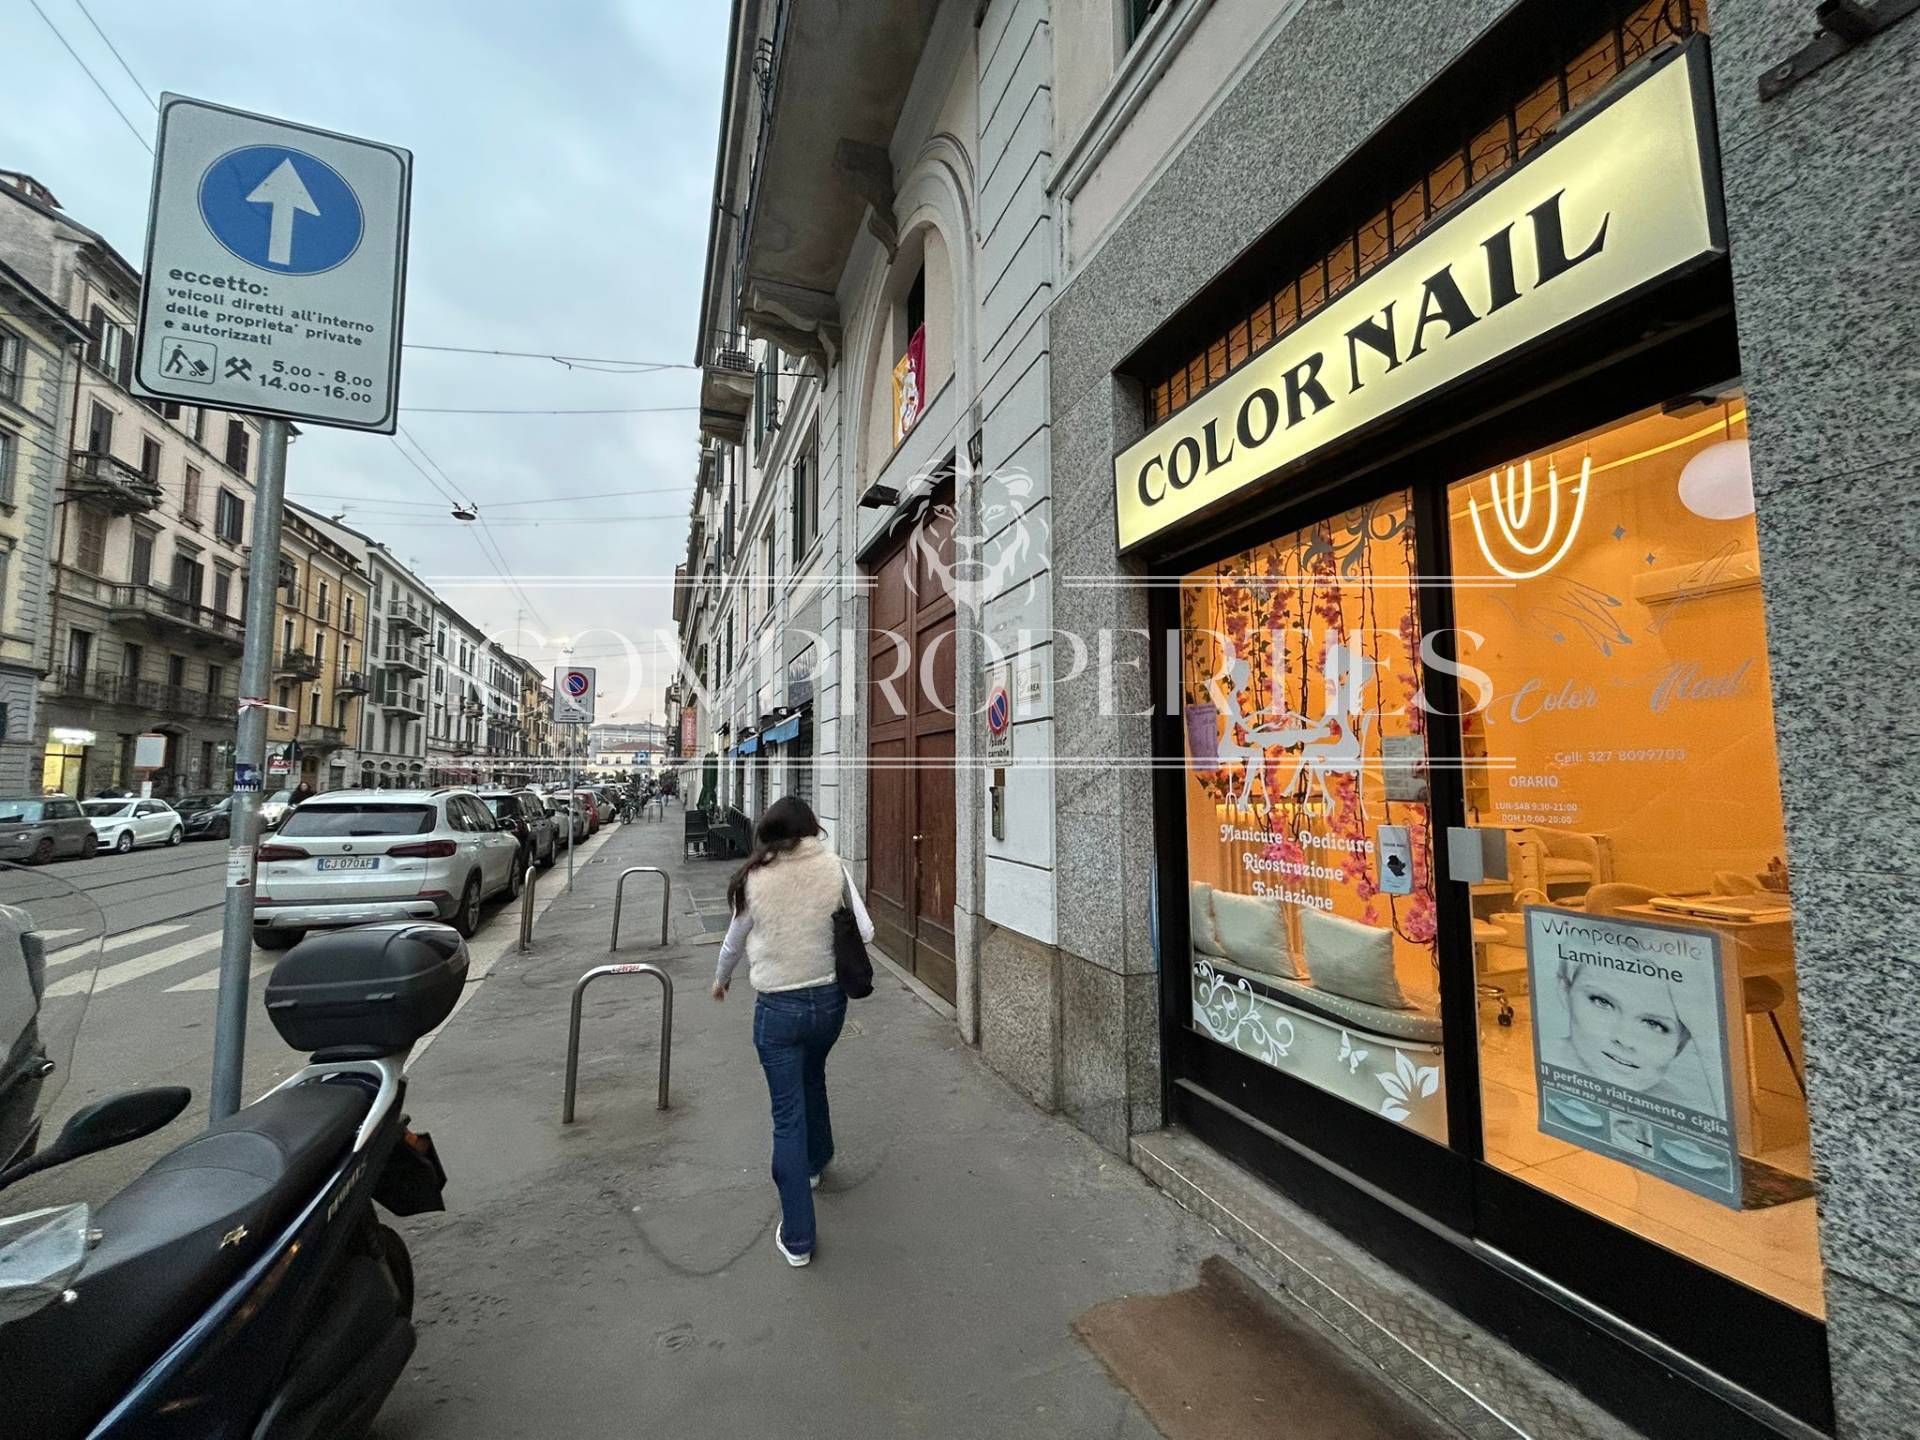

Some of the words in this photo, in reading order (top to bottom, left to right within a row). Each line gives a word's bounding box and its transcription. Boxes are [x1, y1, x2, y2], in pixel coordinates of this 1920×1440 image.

[168, 268, 269, 297] eccetto:
[165, 302, 209, 319] delle
[305, 328, 363, 346] private
[167, 287, 225, 306] veicoli
[231, 297, 284, 316] diretti
[290, 308, 375, 333] all'interno
[164, 319, 175, 329] e
[181, 321, 272, 346] autorizzati
[1137, 351, 1335, 507] COLOR
[1342, 187, 1611, 394] NAIL
[272, 359, 312, 378] 5.00
[334, 370, 373, 388] 8.00
[258, 374, 372, 404] 14.00-16.00
[1485, 678, 1599, 725] Color
[1588, 751, 1613, 763] 327
[1508, 775, 1559, 788] ORARIO
[1219, 823, 1283, 844] Manicure
[1299, 830, 1375, 853] Pedicure
[1242, 852, 1344, 881] Ricostruzione
[1252, 880, 1334, 910] Epilazione
[1557, 943, 1684, 984] Laminazione
[1541, 1063, 1549, 1076] Il
[1552, 1071, 1602, 1093] perfetto
[1606, 1086, 1686, 1121] rialzamento
[1691, 1115, 1729, 1136] ciglia
